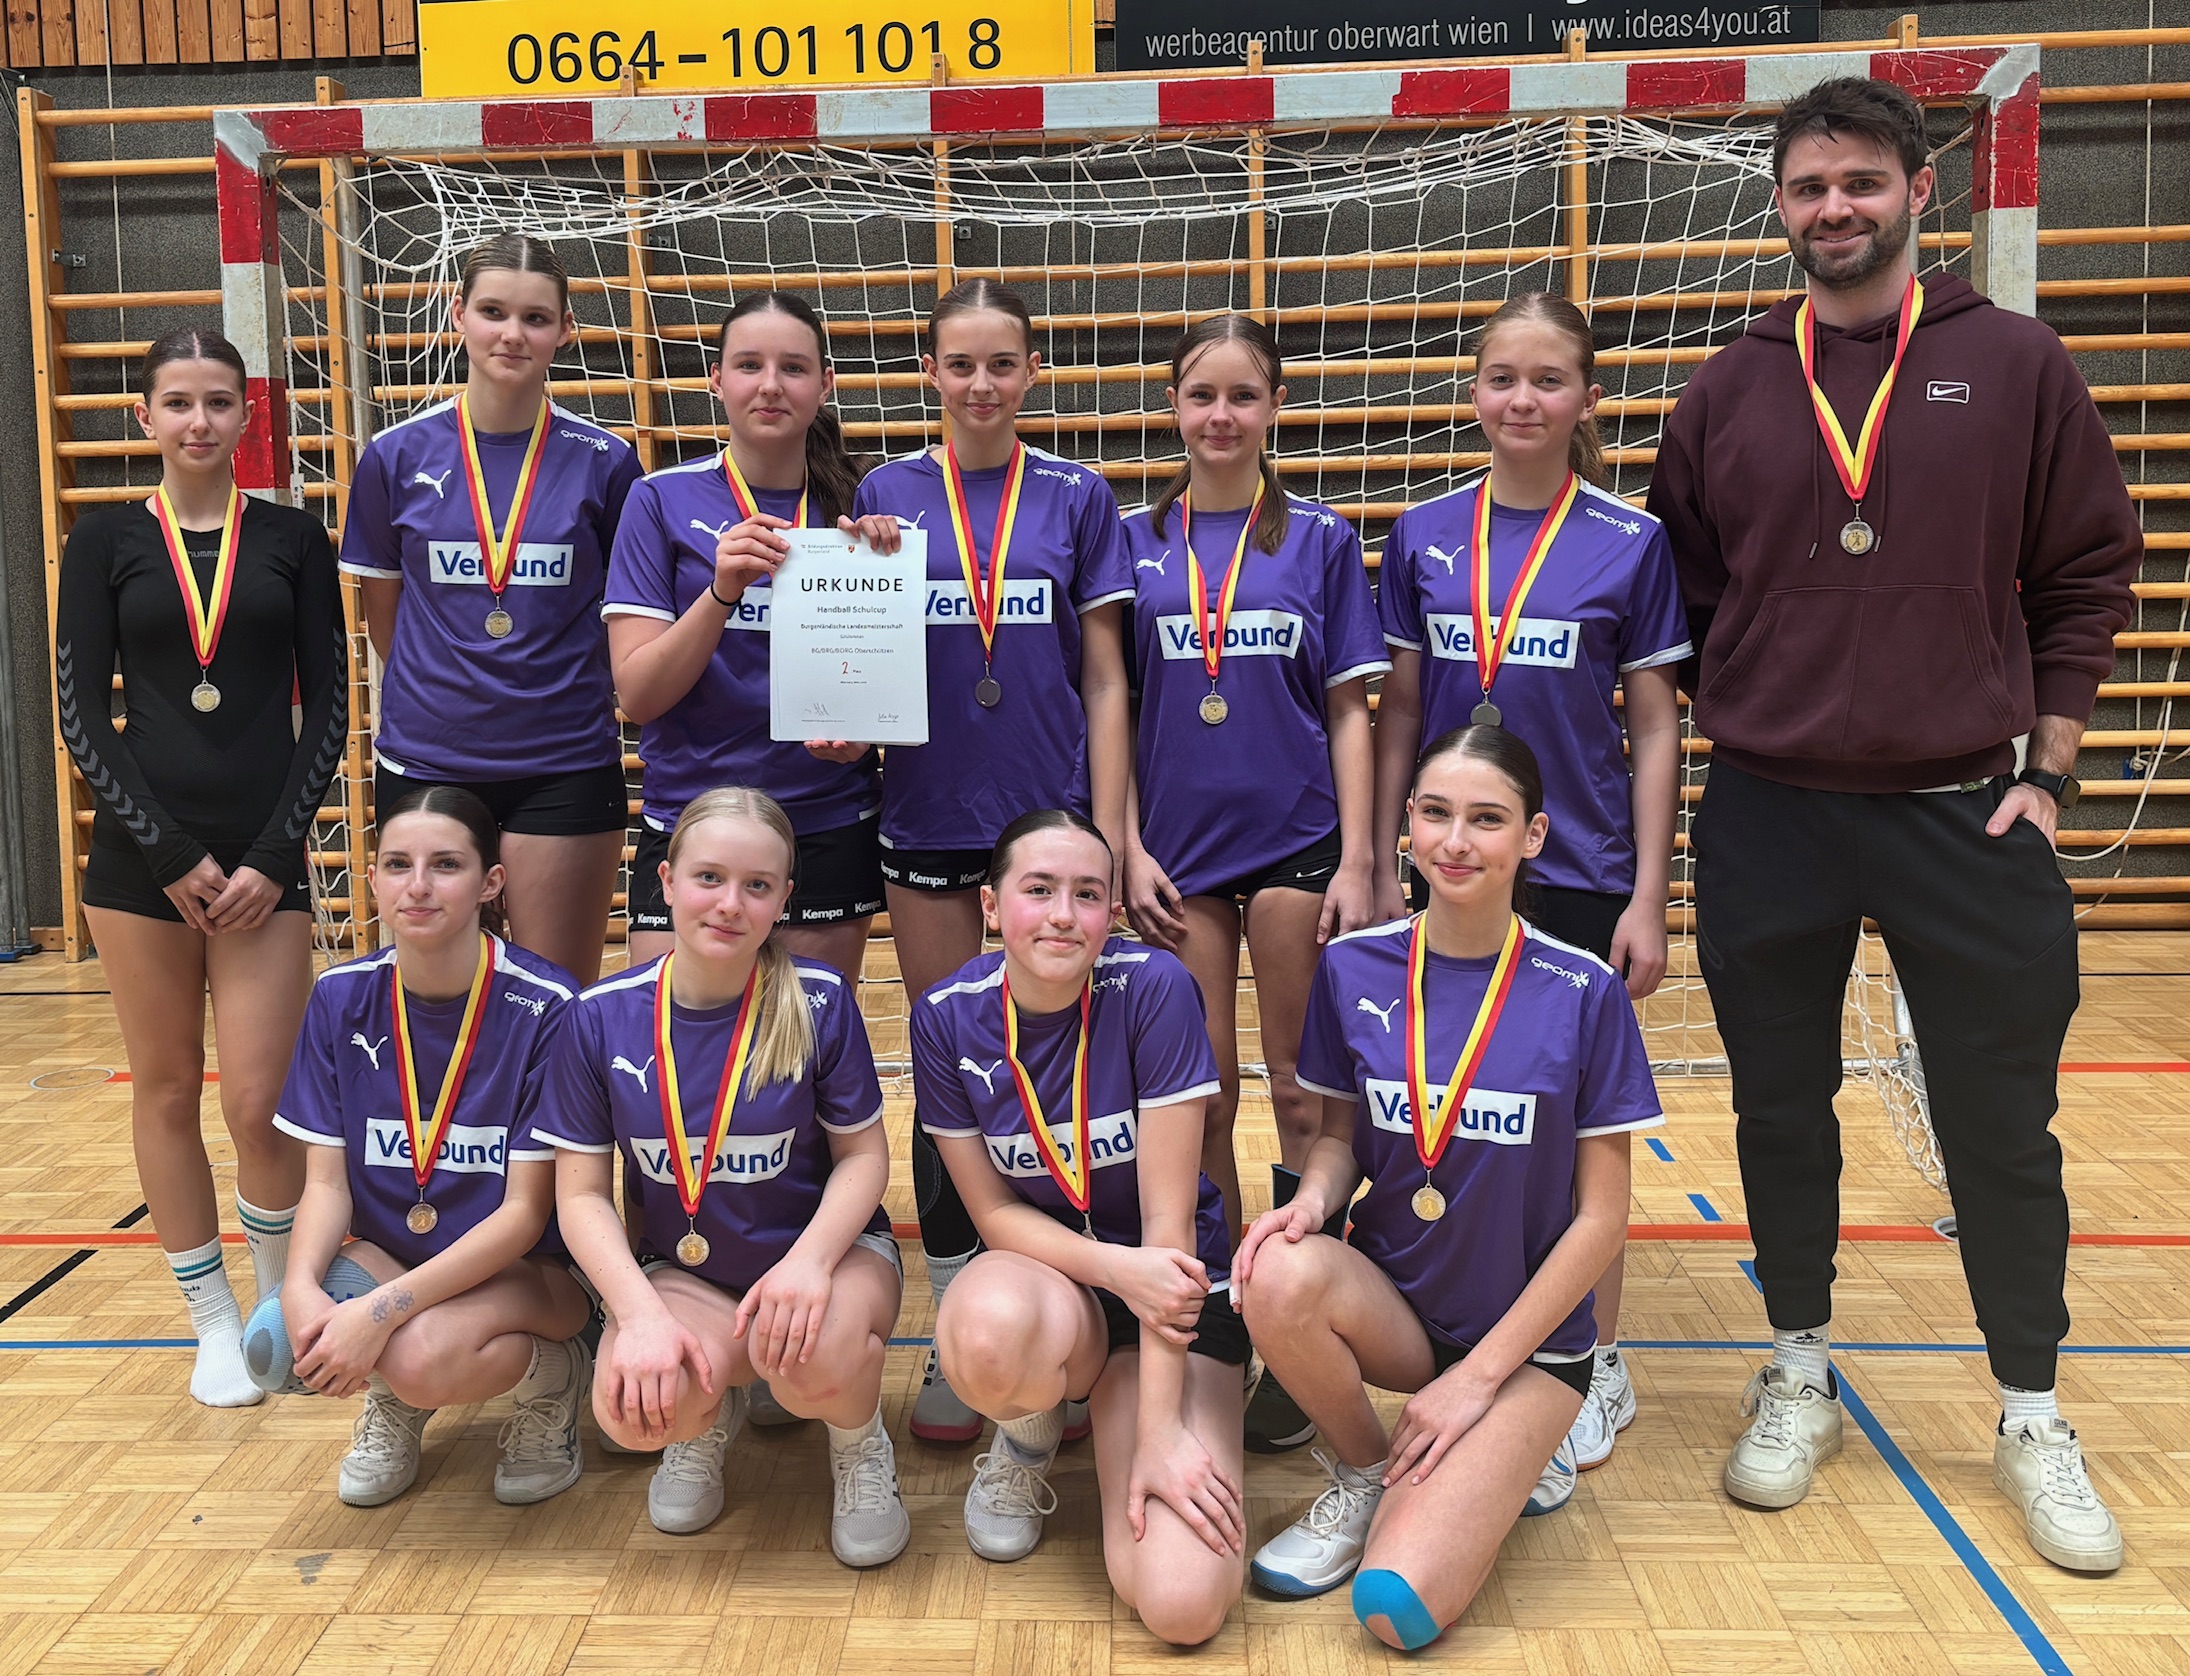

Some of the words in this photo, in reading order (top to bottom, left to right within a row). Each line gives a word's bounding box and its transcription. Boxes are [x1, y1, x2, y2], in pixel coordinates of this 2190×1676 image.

[1145, 24, 1319, 61] werbeagentur
[1327, 18, 1440, 51] oberwart
[1447, 15, 1509, 46] wien
[1551, 4, 1792, 43] www.ideas4you.at
[845, 20, 940, 74] 101
[968, 17, 1001, 70] 8
[437, 550, 566, 578] Verund
[801, 577, 904, 592] URKUNDE
[817, 605, 852, 614] Handball
[852, 605, 888, 615] Schulcup
[1433, 622, 1571, 659] Veund
[841, 661, 849, 675] 2
[908, 870, 948, 888] Kempa
[637, 912, 668, 927] Kempa
[802, 906, 844, 921] Kempa
[854, 898, 882, 914] Kempa
[1374, 1089, 1526, 1136] Veund
